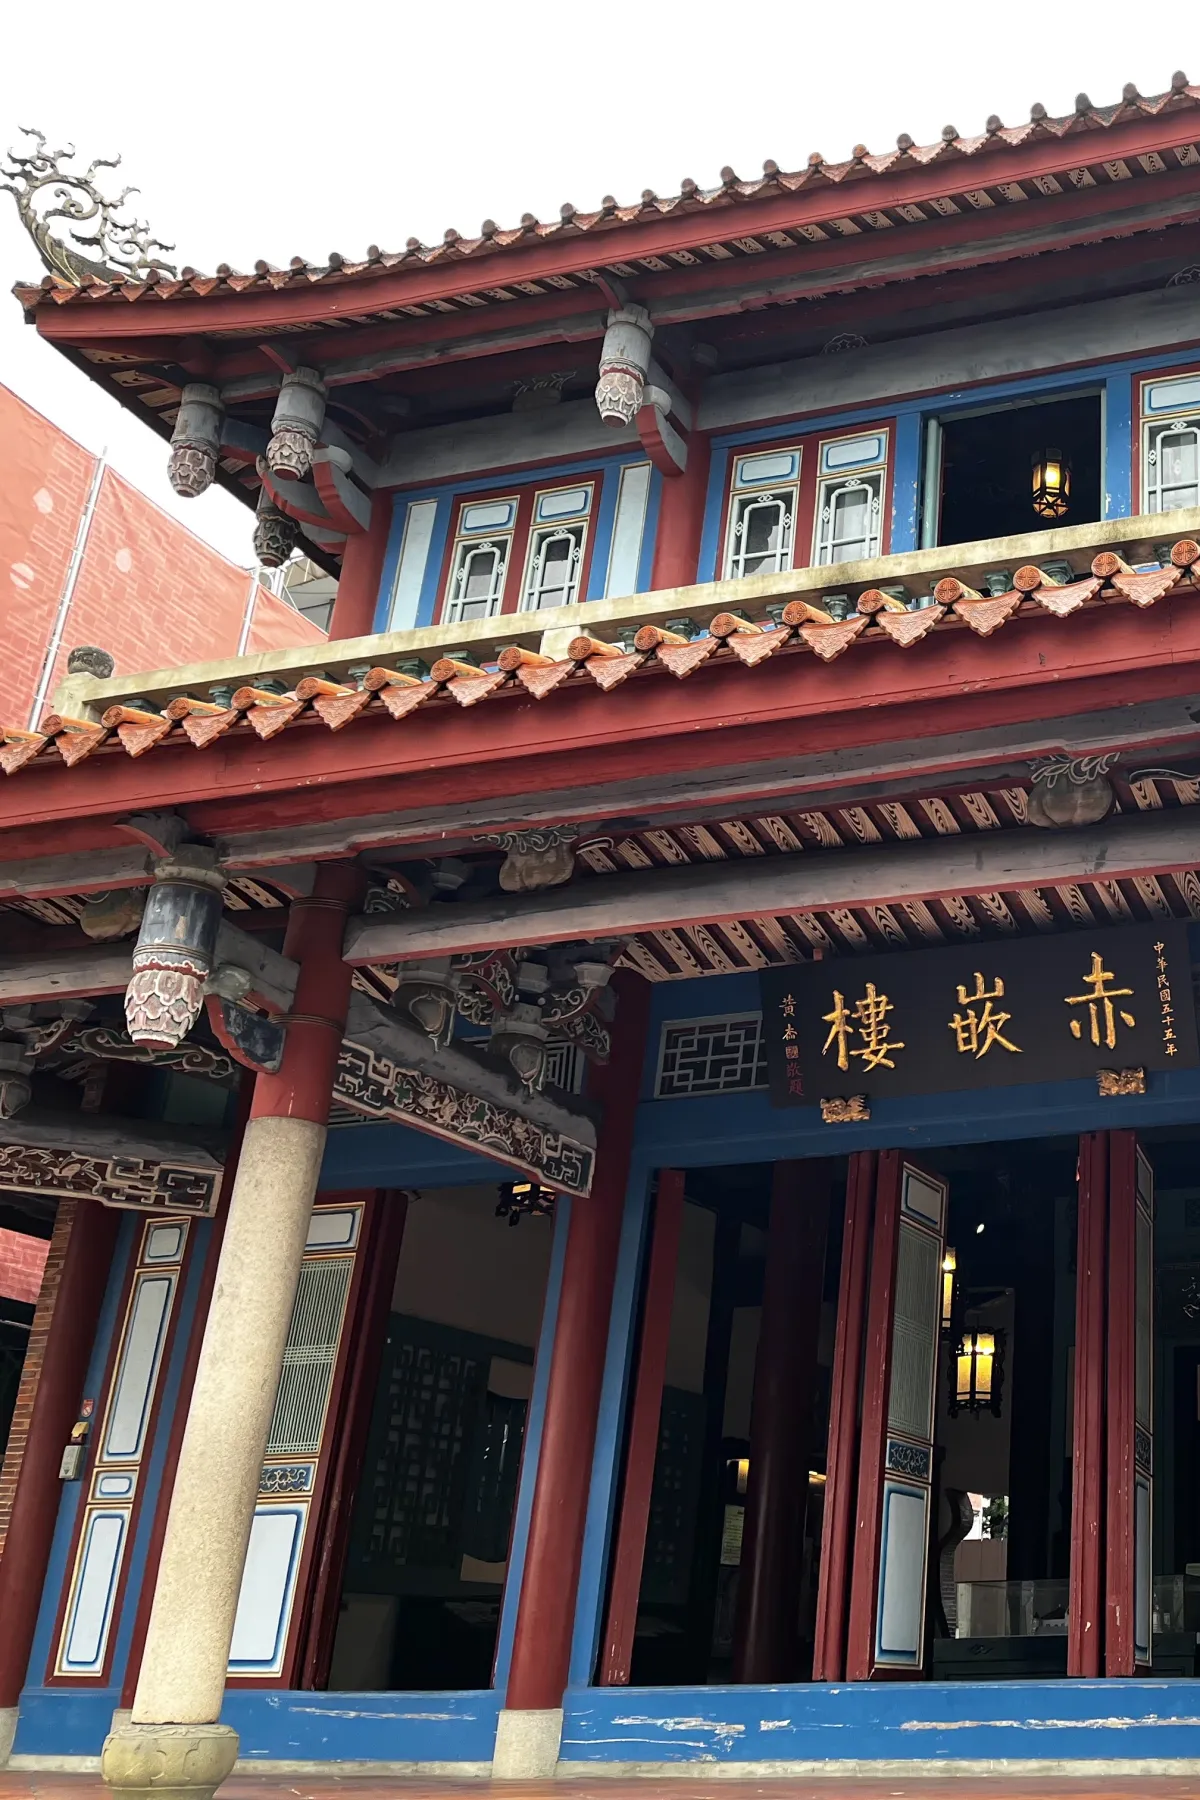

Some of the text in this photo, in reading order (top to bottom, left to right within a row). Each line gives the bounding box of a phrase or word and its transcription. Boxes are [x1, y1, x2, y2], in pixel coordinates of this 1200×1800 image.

[821, 951, 1136, 1073] 赤嵌樓
[1153, 941, 1178, 1057] 中華民國五十五年
